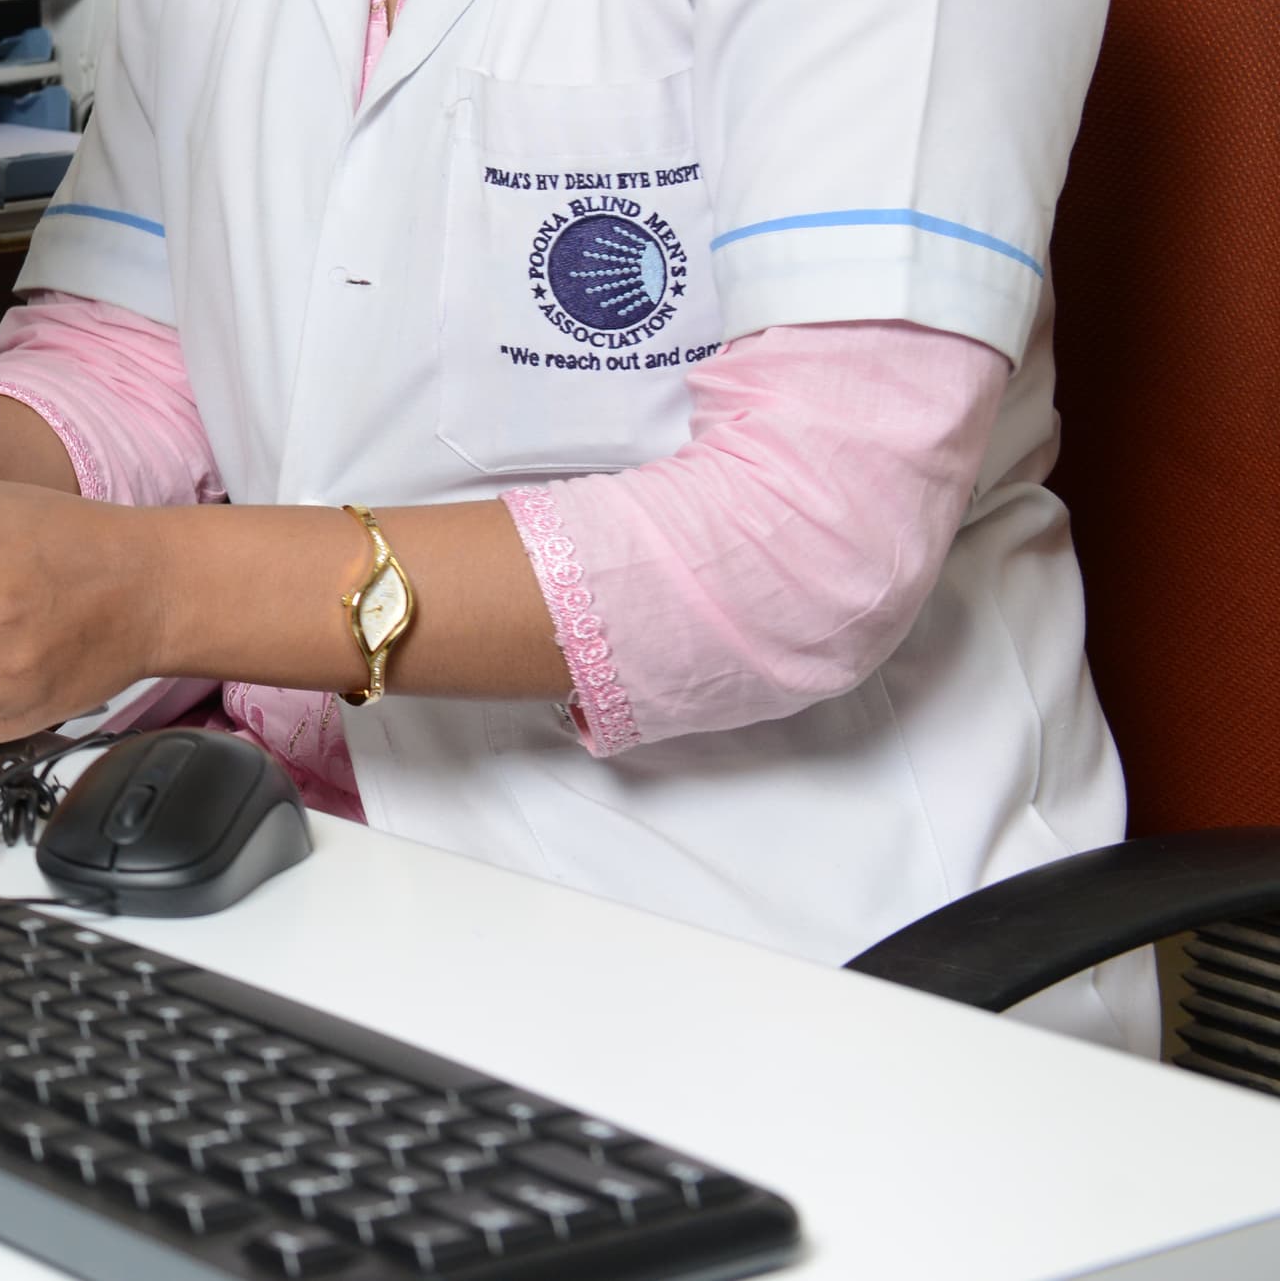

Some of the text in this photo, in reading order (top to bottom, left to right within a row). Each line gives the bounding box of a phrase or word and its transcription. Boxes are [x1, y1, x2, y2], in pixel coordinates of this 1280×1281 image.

[535, 174, 559, 190] HV
[564, 173, 612, 190] DESAI
[616, 172, 651, 189] EYE
[529, 195, 688, 280] POONA BLIND MEN'S
[540, 303, 678, 350] ASSOCIATION
[545, 352, 601, 371] reach
[606, 352, 641, 371] out
[645, 346, 681, 369] and
